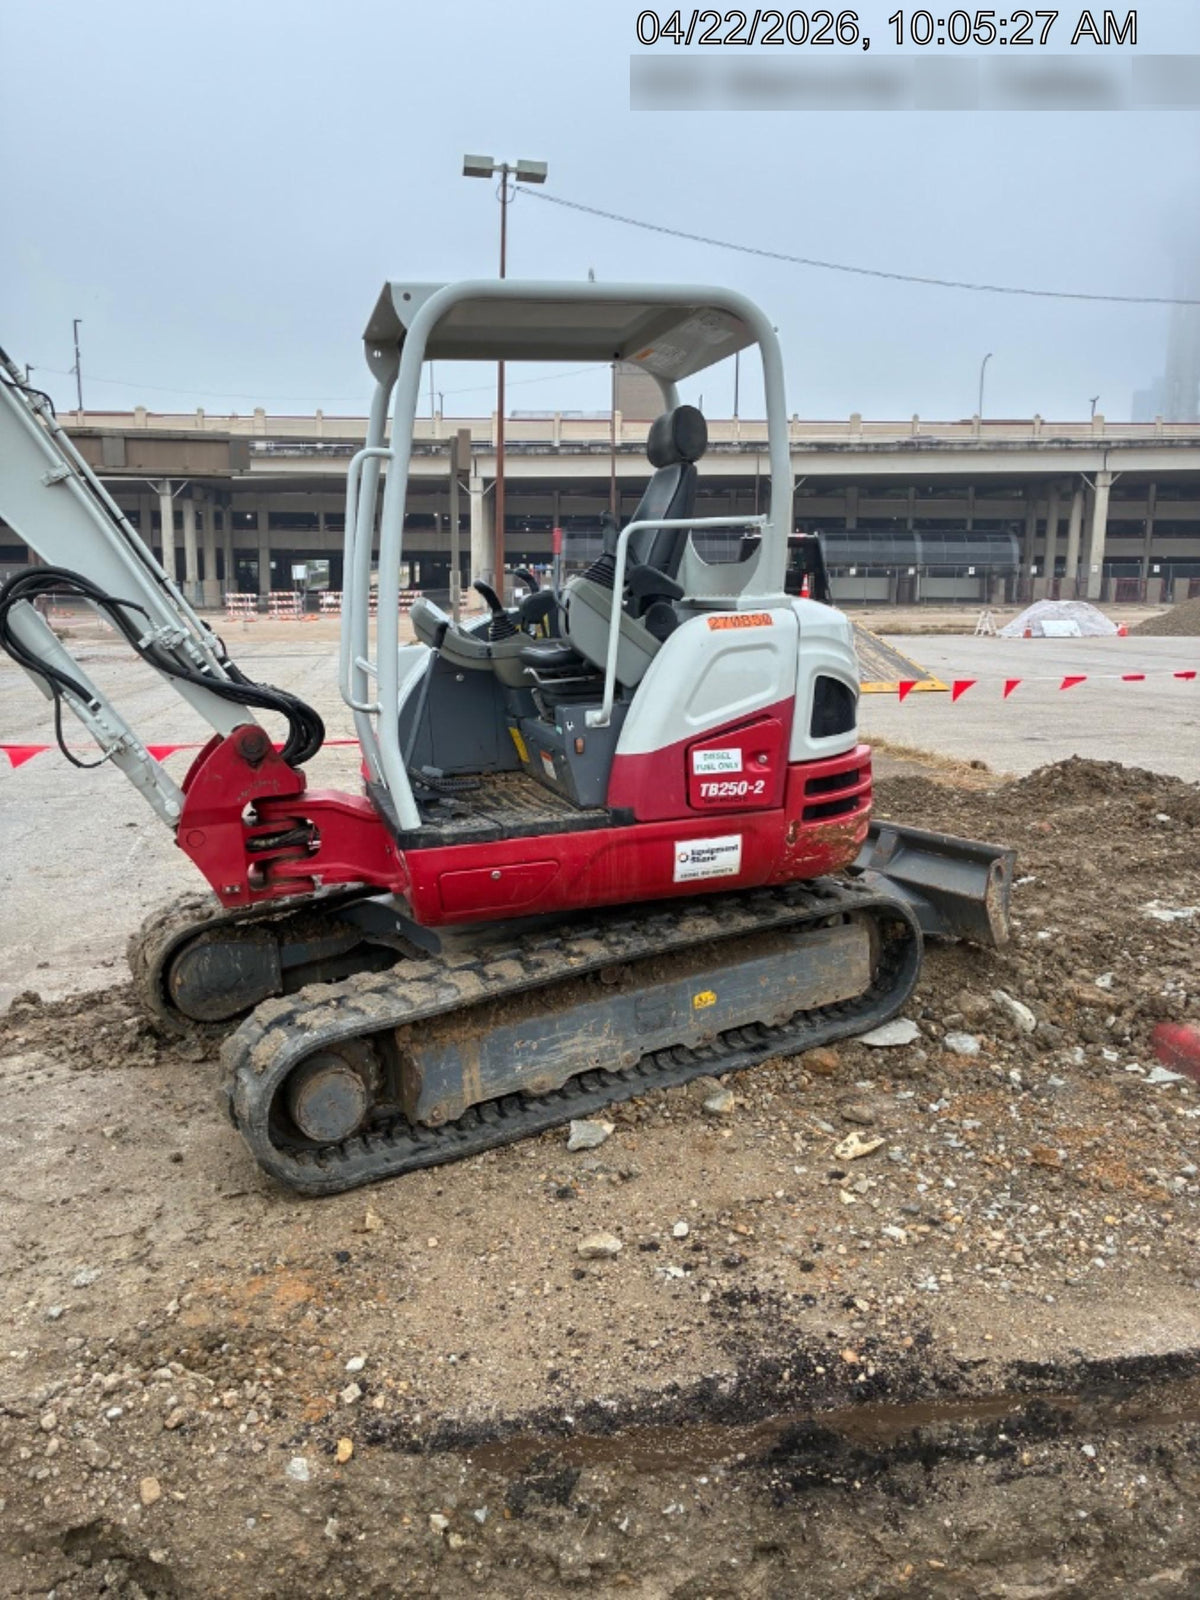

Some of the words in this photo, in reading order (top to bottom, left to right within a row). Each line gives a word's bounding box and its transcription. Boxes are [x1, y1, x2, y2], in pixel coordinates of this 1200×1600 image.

[703, 751, 732, 761] DIESEL
[696, 763, 717, 772] FUEL
[718, 762, 739, 770] ONLY
[700, 779, 765, 798] TB250-2
